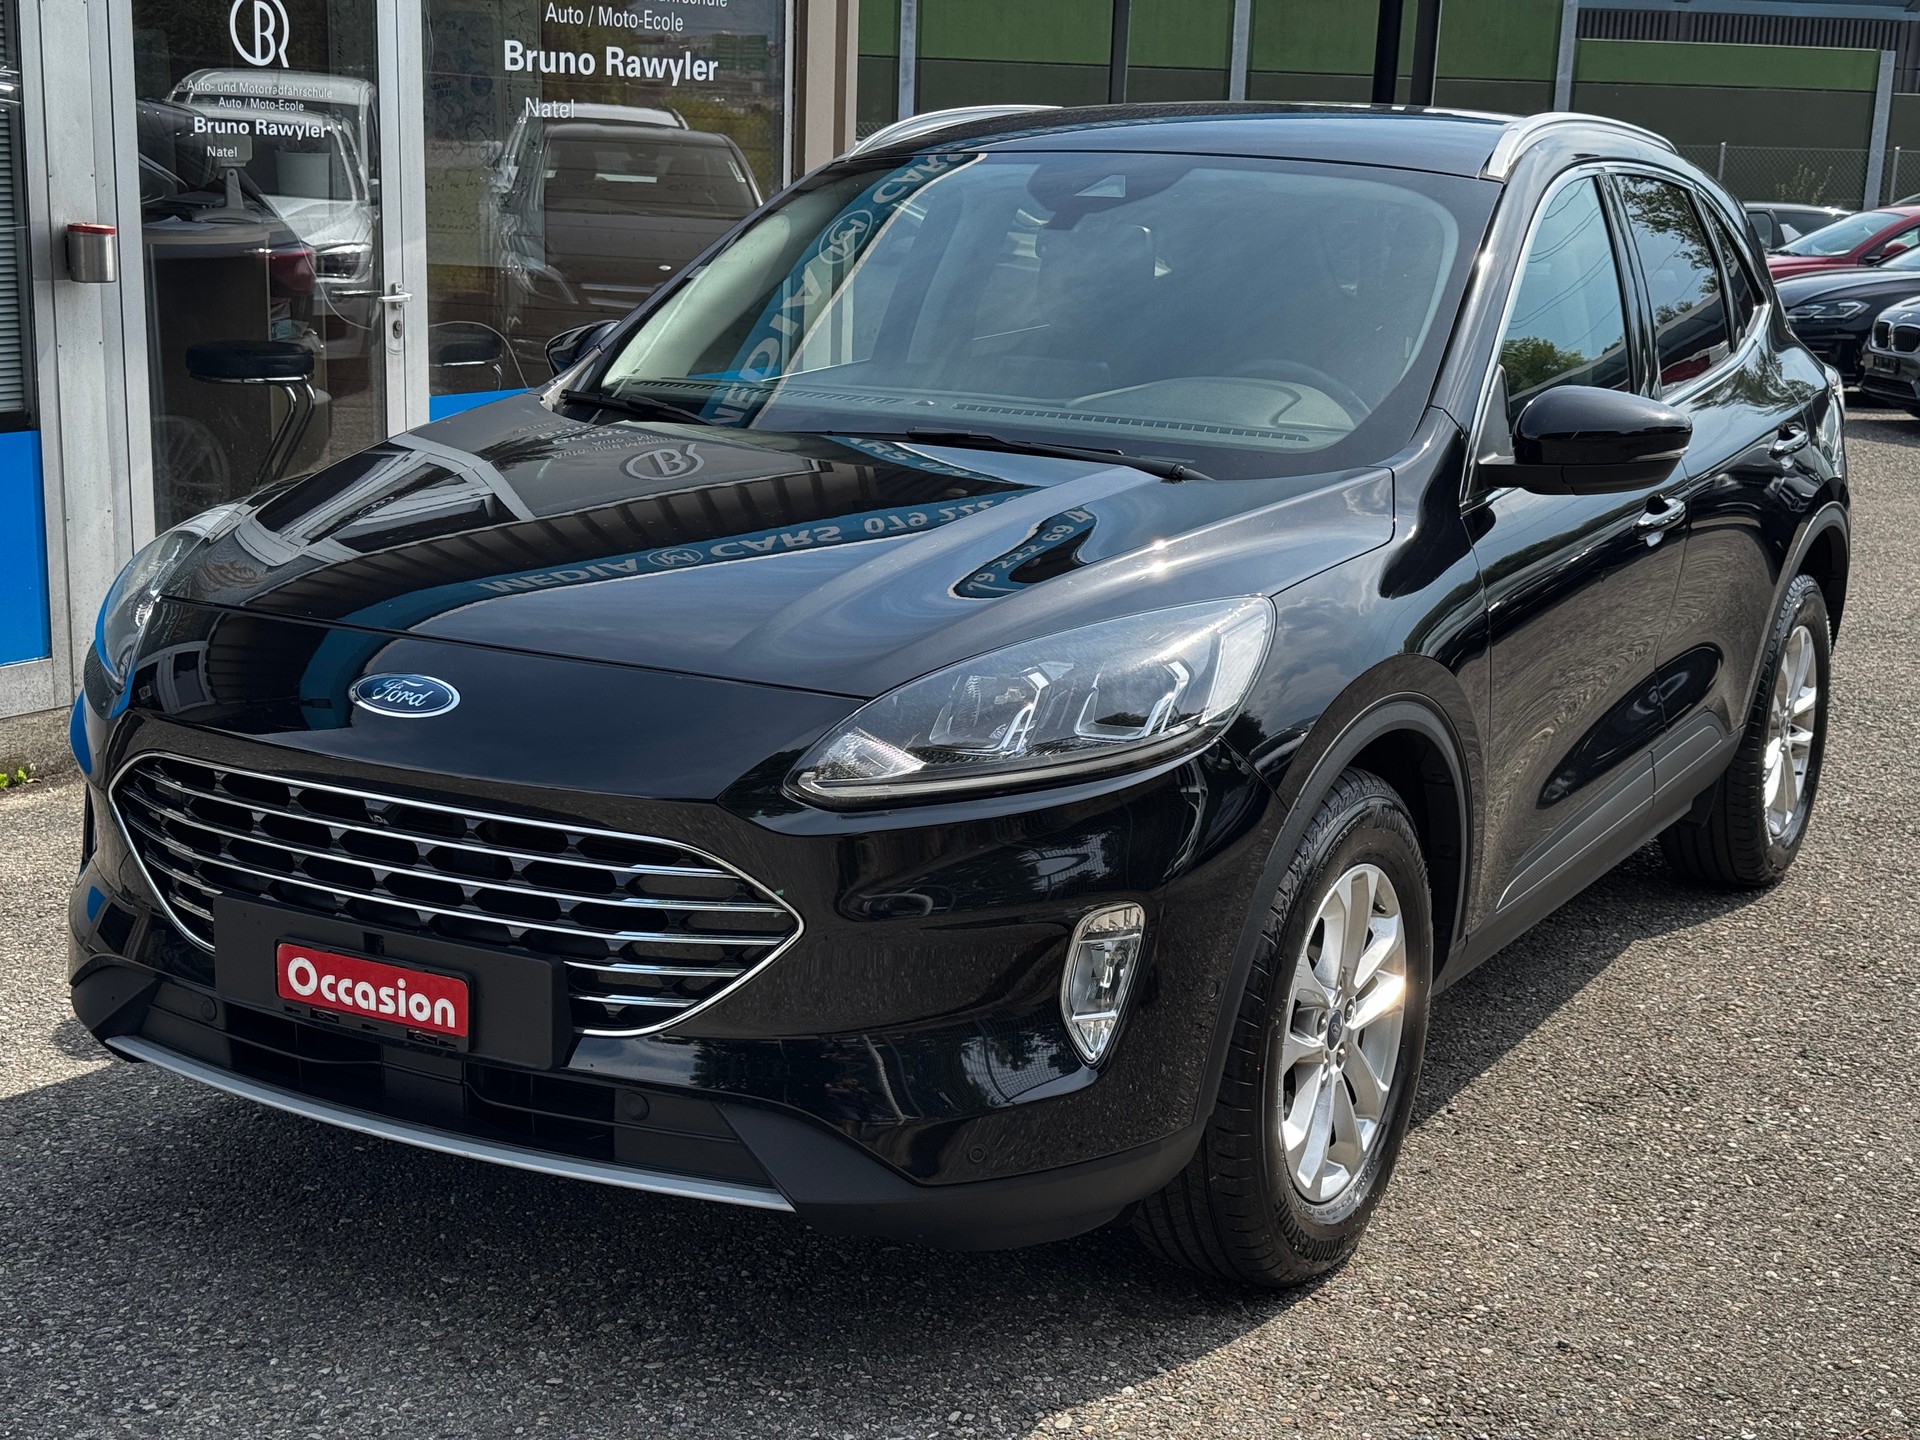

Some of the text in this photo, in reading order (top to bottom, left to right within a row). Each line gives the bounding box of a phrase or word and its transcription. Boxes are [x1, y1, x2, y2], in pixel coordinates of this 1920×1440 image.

[545, 3, 684, 31] Auto / Moto-Ecole
[504, 39, 719, 87] Bruno Rawyler
[186, 80, 333, 99] Auto- und Motorradfahrschule
[218, 97, 304, 112] Auto / Moto-Ecole
[525, 97, 575, 119] Natel
[193, 117, 327, 140] Bruno Rawyler
[207, 146, 238, 158] Natel
[371, 678, 434, 708] Ford
[287, 957, 456, 1028] Occasion
